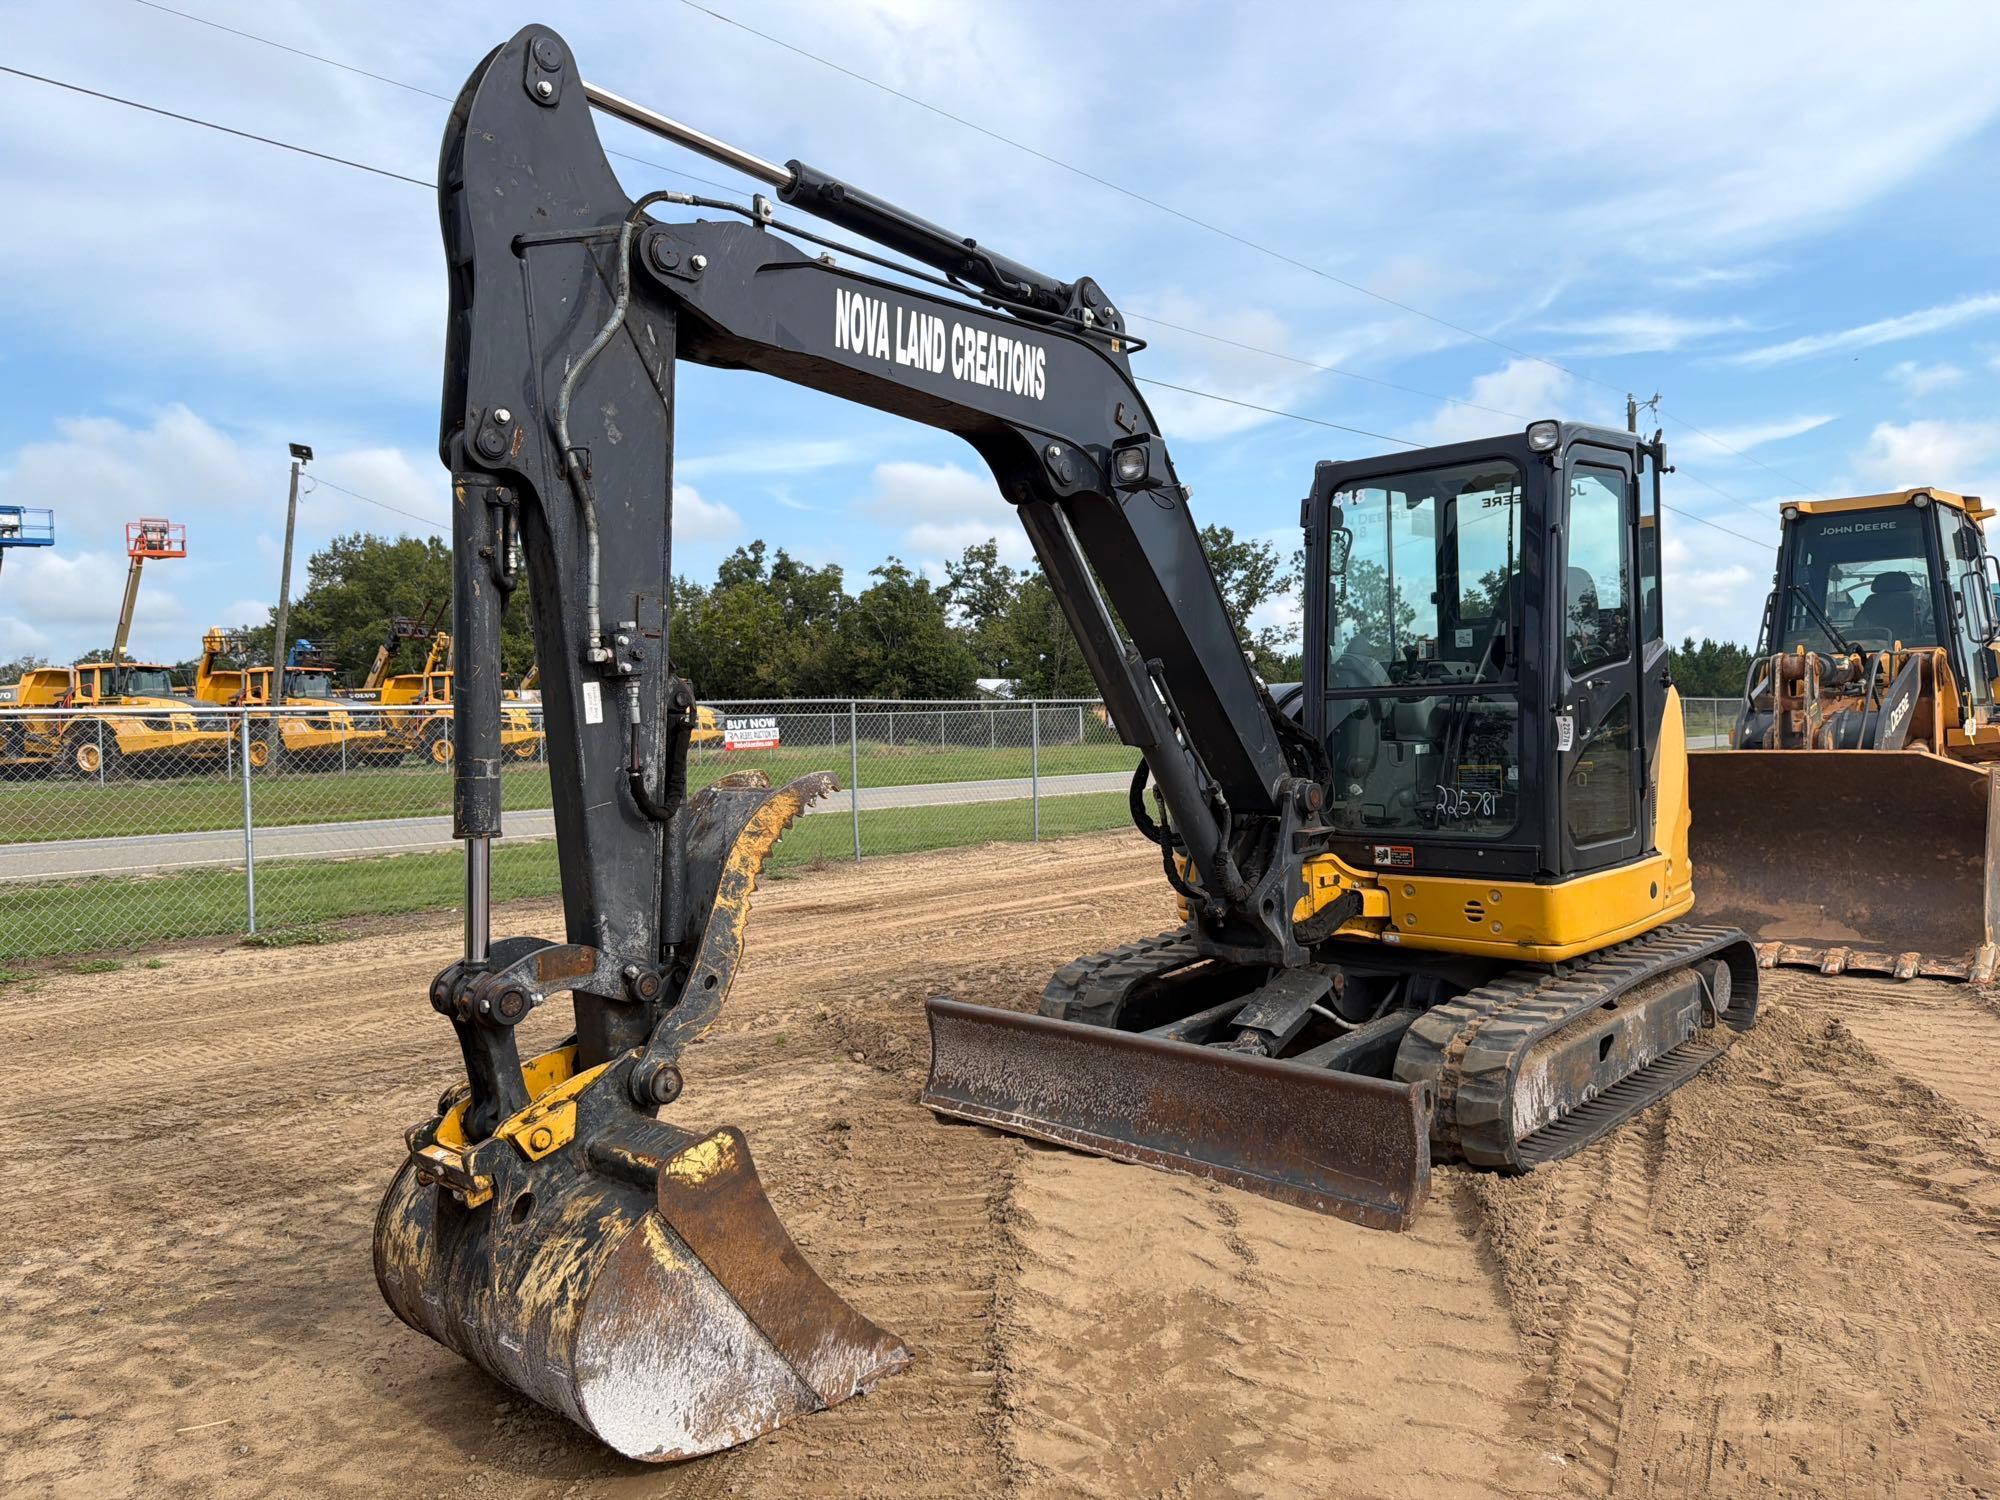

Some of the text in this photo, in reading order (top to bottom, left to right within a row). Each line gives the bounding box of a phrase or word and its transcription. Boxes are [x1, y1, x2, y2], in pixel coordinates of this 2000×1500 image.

[835, 288, 1046, 401] NOVA LAND CREATIONS
[1820, 521, 1897, 536] JOHN DEERE
[726, 717, 776, 730] BUY NOW
[1890, 692, 1910, 733] DEERE
[1435, 784, 1496, 819] 225781
